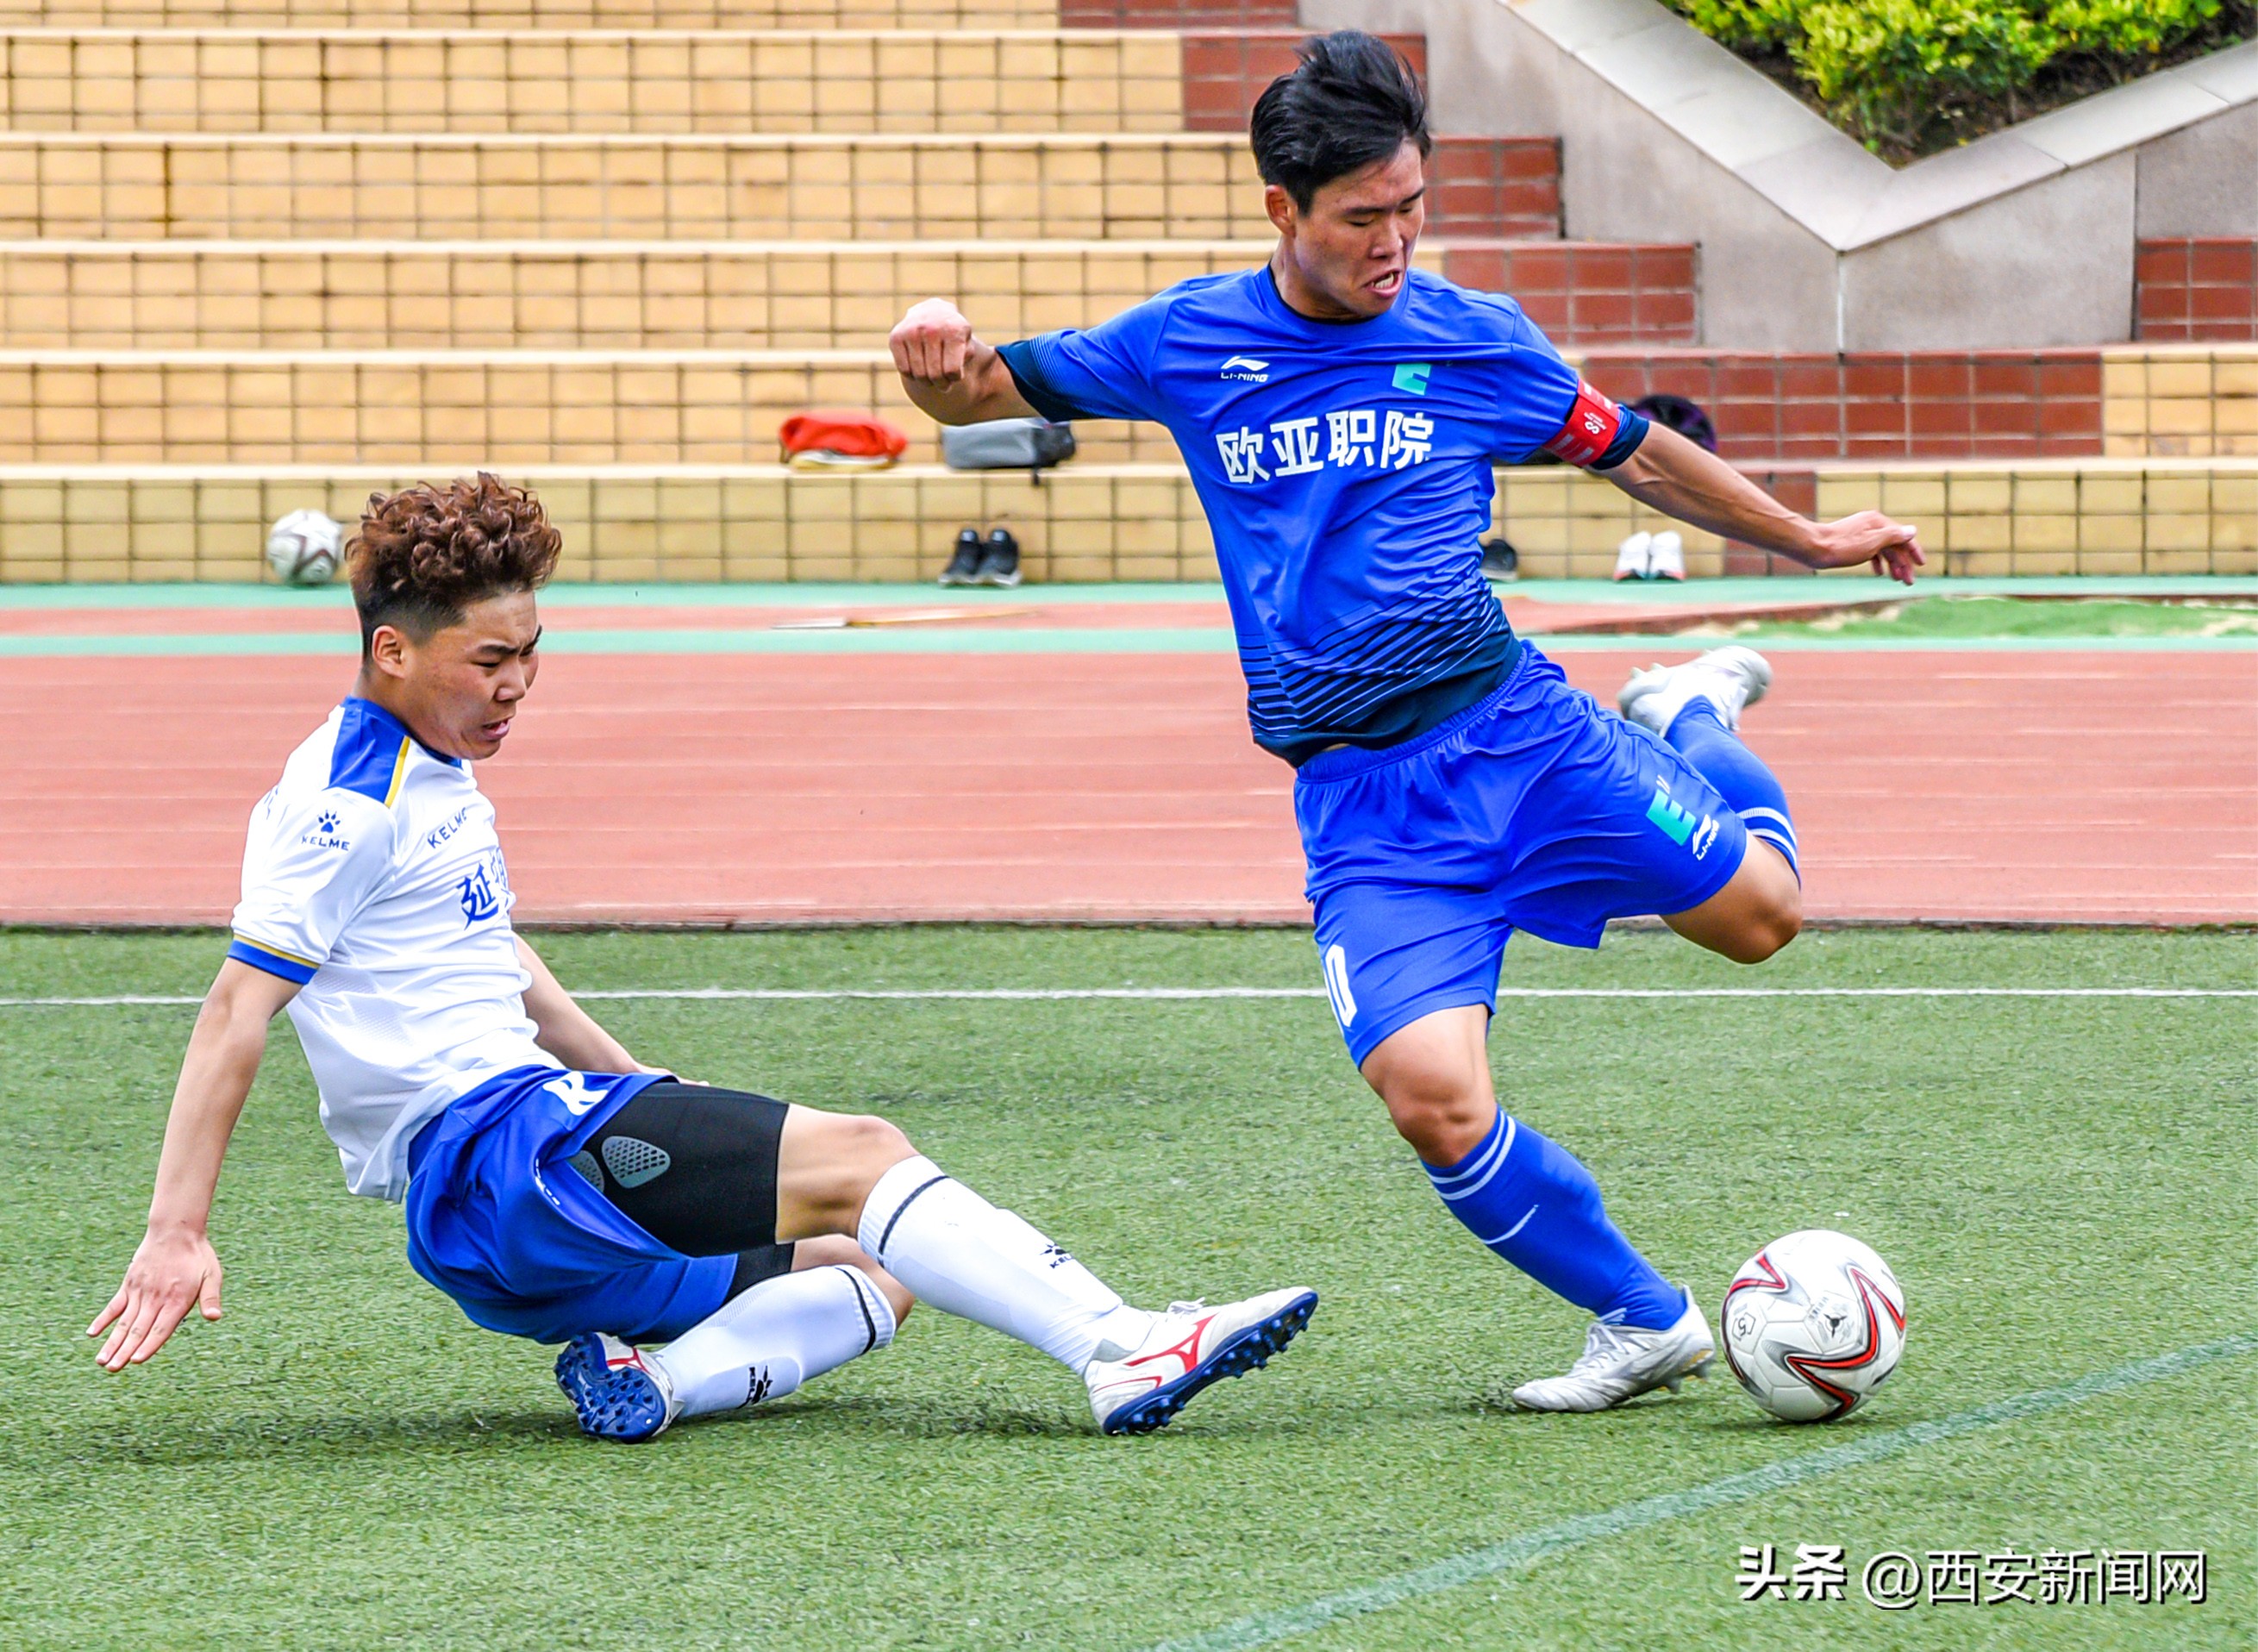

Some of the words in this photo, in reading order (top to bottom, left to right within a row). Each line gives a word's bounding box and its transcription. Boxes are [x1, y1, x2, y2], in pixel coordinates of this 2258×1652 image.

[1221, 372, 1268, 383] LI-NING
[1216, 410, 1434, 484] 欧亚职院
[302, 835, 350, 851] KELME
[456, 849, 509, 930] 延
[1737, 1317, 1747, 1336] 5
